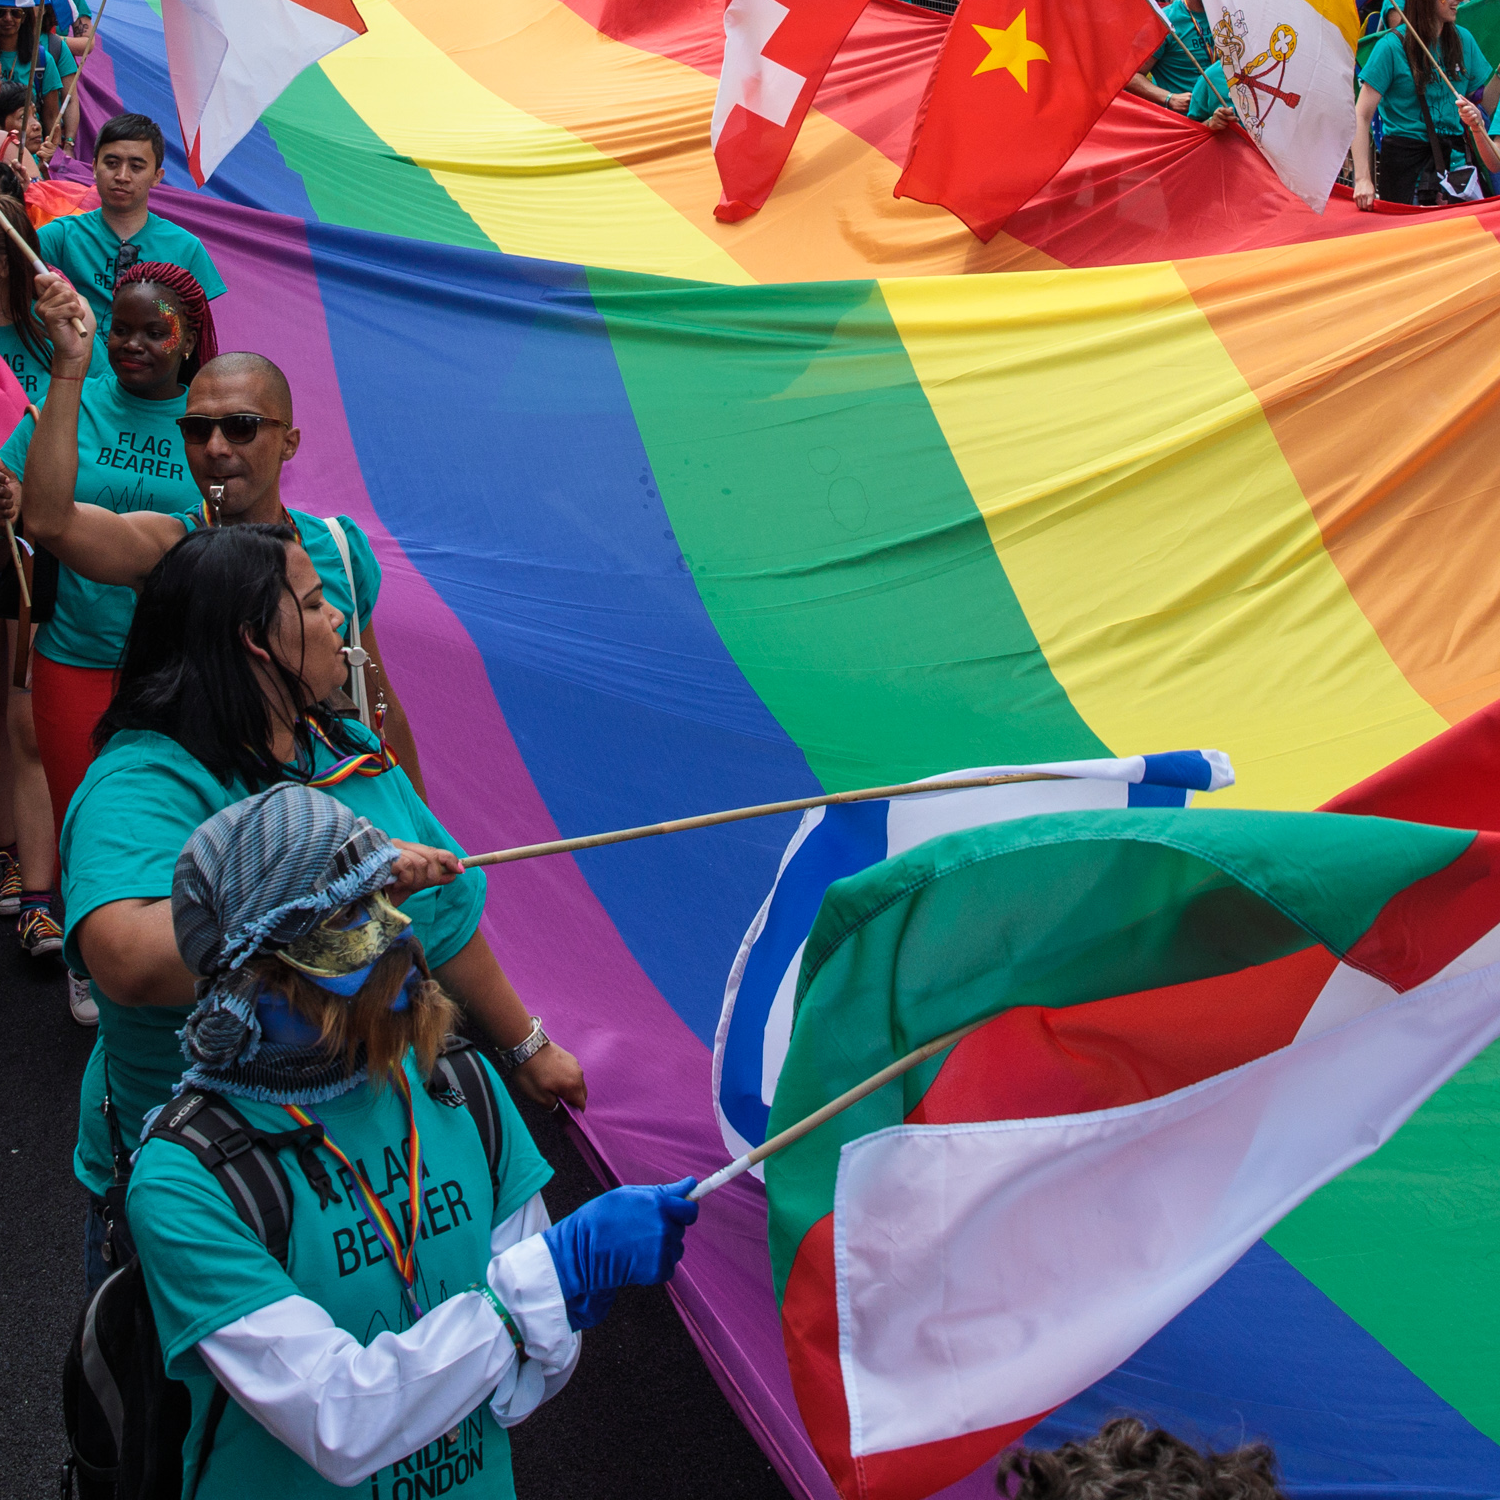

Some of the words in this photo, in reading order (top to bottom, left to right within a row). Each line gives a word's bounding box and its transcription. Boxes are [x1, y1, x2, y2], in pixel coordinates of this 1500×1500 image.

[118, 431, 172, 459] FLAG
[95, 447, 184, 481] BEARER
[168, 1095, 204, 1128] OGIO
[462, 1408, 485, 1450] IN
